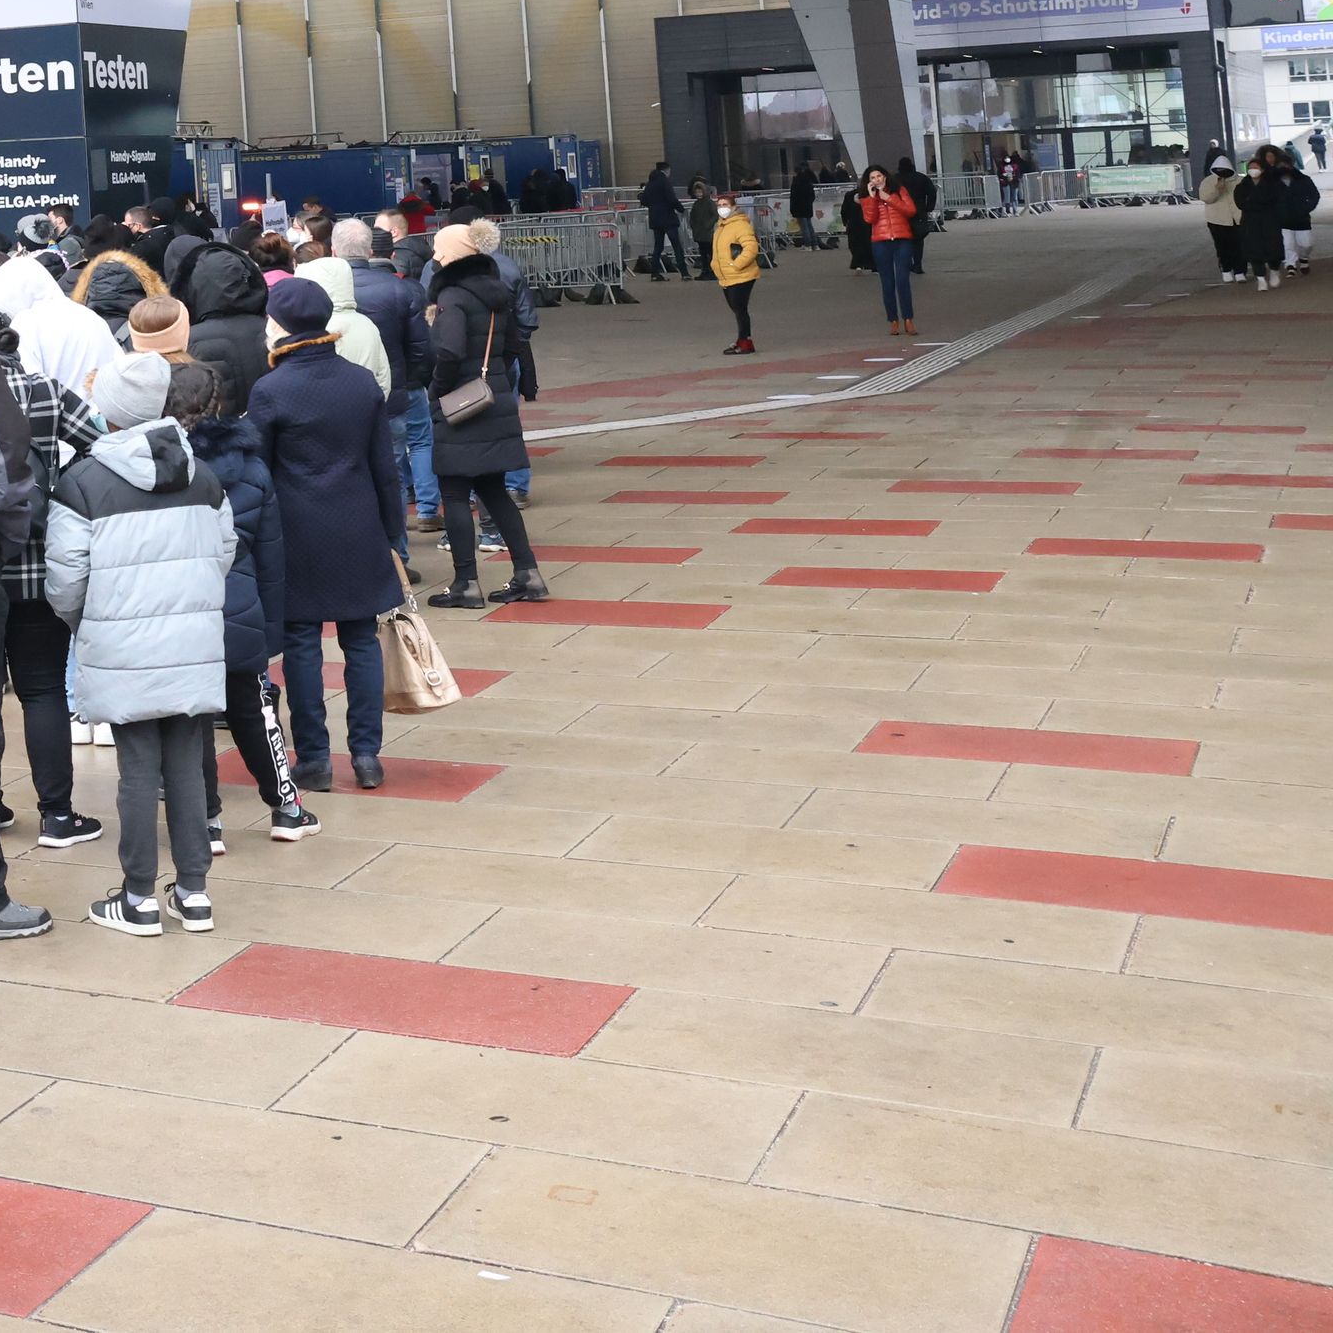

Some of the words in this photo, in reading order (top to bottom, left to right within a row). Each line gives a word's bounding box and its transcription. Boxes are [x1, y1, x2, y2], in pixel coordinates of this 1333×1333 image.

[83, 51, 148, 90] Testen
[110, 150, 156, 164] Handy-Signatur
[111, 172, 146, 184] ELGA-Point
